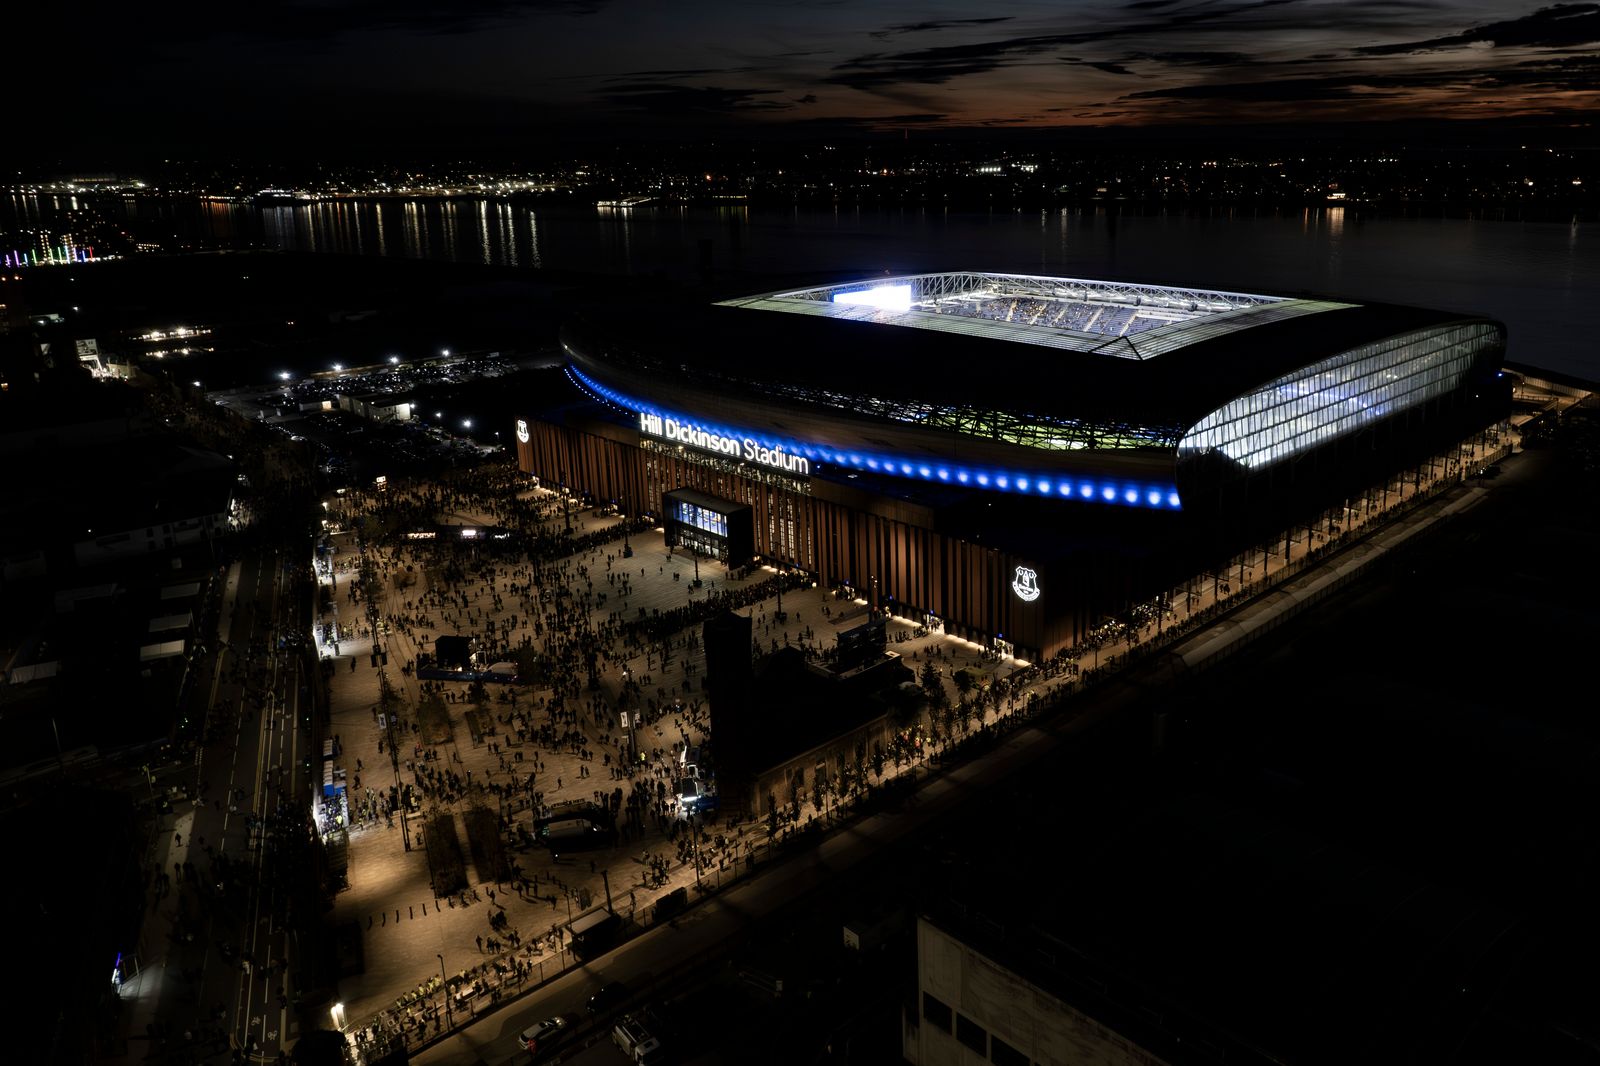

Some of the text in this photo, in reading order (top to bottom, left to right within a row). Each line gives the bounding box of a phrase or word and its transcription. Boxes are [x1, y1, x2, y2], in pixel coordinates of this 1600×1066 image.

[640, 412, 809, 474] Hill Dickinson Stadium
